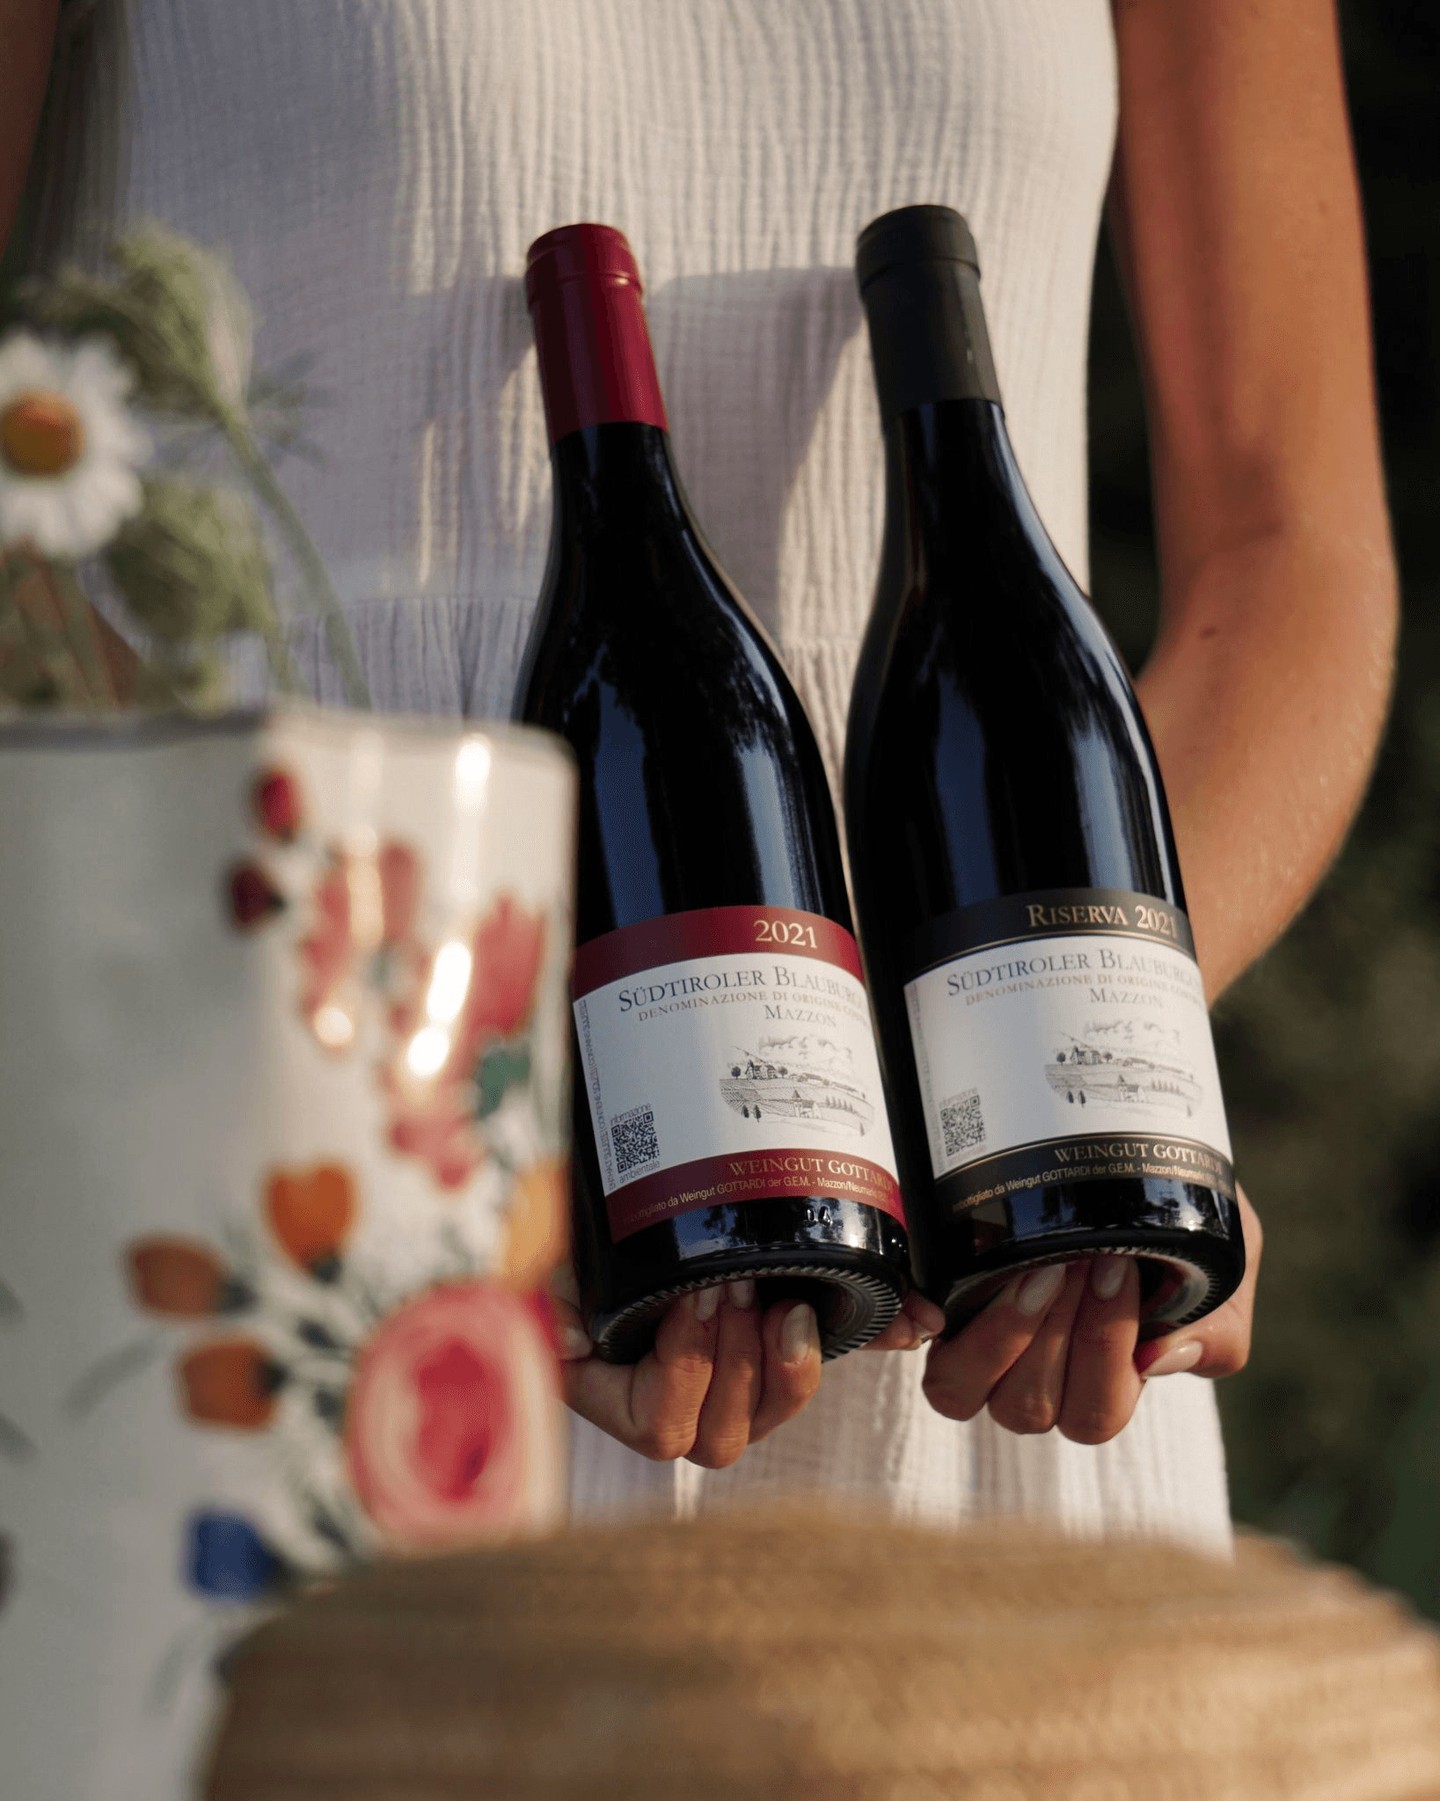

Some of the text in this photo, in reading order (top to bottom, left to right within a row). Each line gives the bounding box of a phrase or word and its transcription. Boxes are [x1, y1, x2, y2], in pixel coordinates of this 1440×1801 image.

[754, 920, 817, 949] 2021
[1026, 904, 1177, 939] RISERVA 2021
[947, 953, 1090, 996] SÜDTIROLER
[618, 970, 766, 1012] SÜDTIROLER
[965, 974, 1092, 1006] DENOMINAZIONE
[1098, 975, 1113, 985] DI
[1090, 988, 1163, 1008] MAZZON
[638, 991, 767, 1021] DENOMINAZIONE
[773, 991, 788, 1001] DI
[765, 1004, 836, 1027] MAZZON
[729, 1157, 824, 1177] WEINGUT
[1055, 1144, 1149, 1162] WEINGUT
[668, 1196, 679, 1208] da
[679, 1187, 715, 1203] Weingut
[717, 1179, 765, 1194] GOTTARDI
[768, 1178, 781, 1188] der
[995, 1184, 1005, 1195] da
[1006, 1174, 1041, 1191] Weingut
[1042, 1165, 1090, 1182] GOTTARDI
[1092, 1165, 1106, 1175] der
